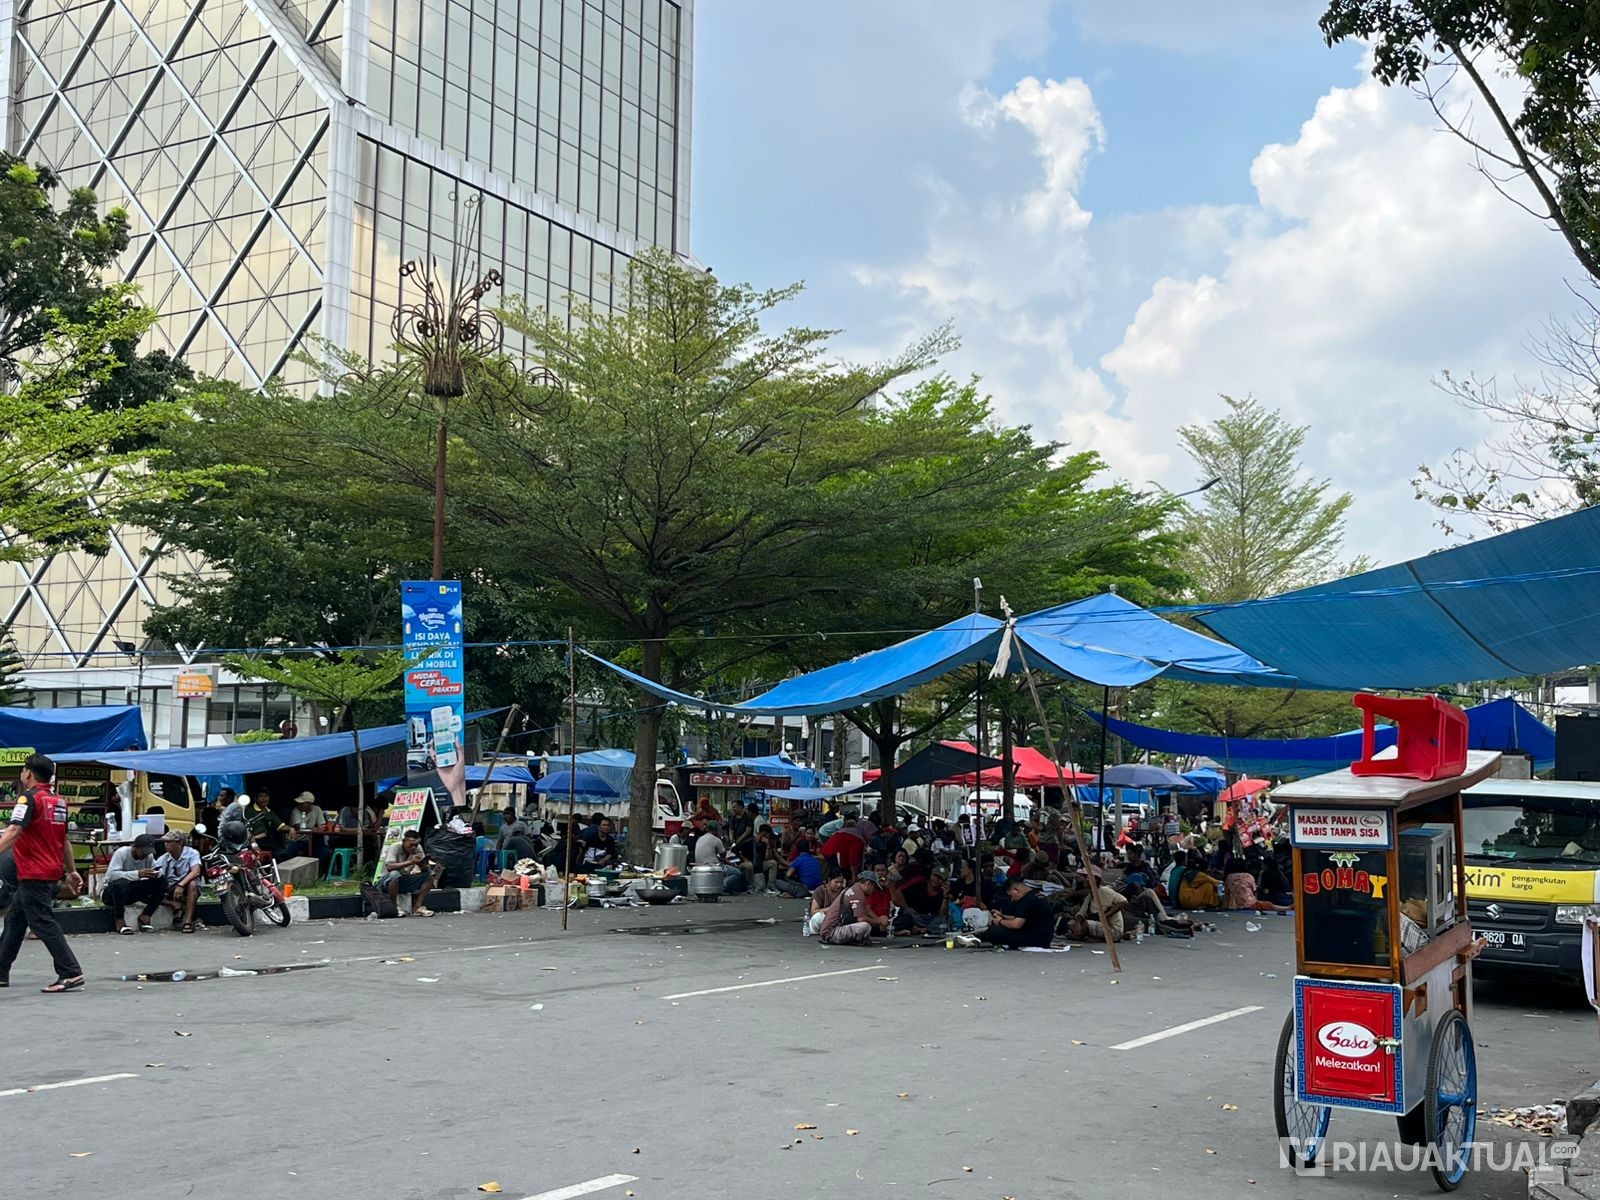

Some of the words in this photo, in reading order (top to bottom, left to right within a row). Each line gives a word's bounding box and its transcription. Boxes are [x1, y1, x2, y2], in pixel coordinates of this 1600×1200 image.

[415, 632, 426, 641] ISI
[428, 632, 451, 641] DAYA
[445, 651, 454, 659] DI
[426, 660, 458, 668] MOBILE
[413, 672, 438, 680] MUDAH
[420, 678, 446, 687] CEPAT
[432, 686, 460, 694] PRAKTIS
[1298, 815, 1329, 825] MASAK
[1331, 815, 1358, 826] PAKAI
[1302, 827, 1328, 837] HABIS
[1330, 827, 1357, 837] TANPA
[1360, 829, 1380, 838] SISA
[1303, 867, 1388, 899] SOMAY
[1511, 875, 1567, 885] pengangkutan
[1511, 882, 1534, 891] kargo
[1325, 1026, 1371, 1049] Sasa
[1315, 1055, 1381, 1073] Melezatkan!
